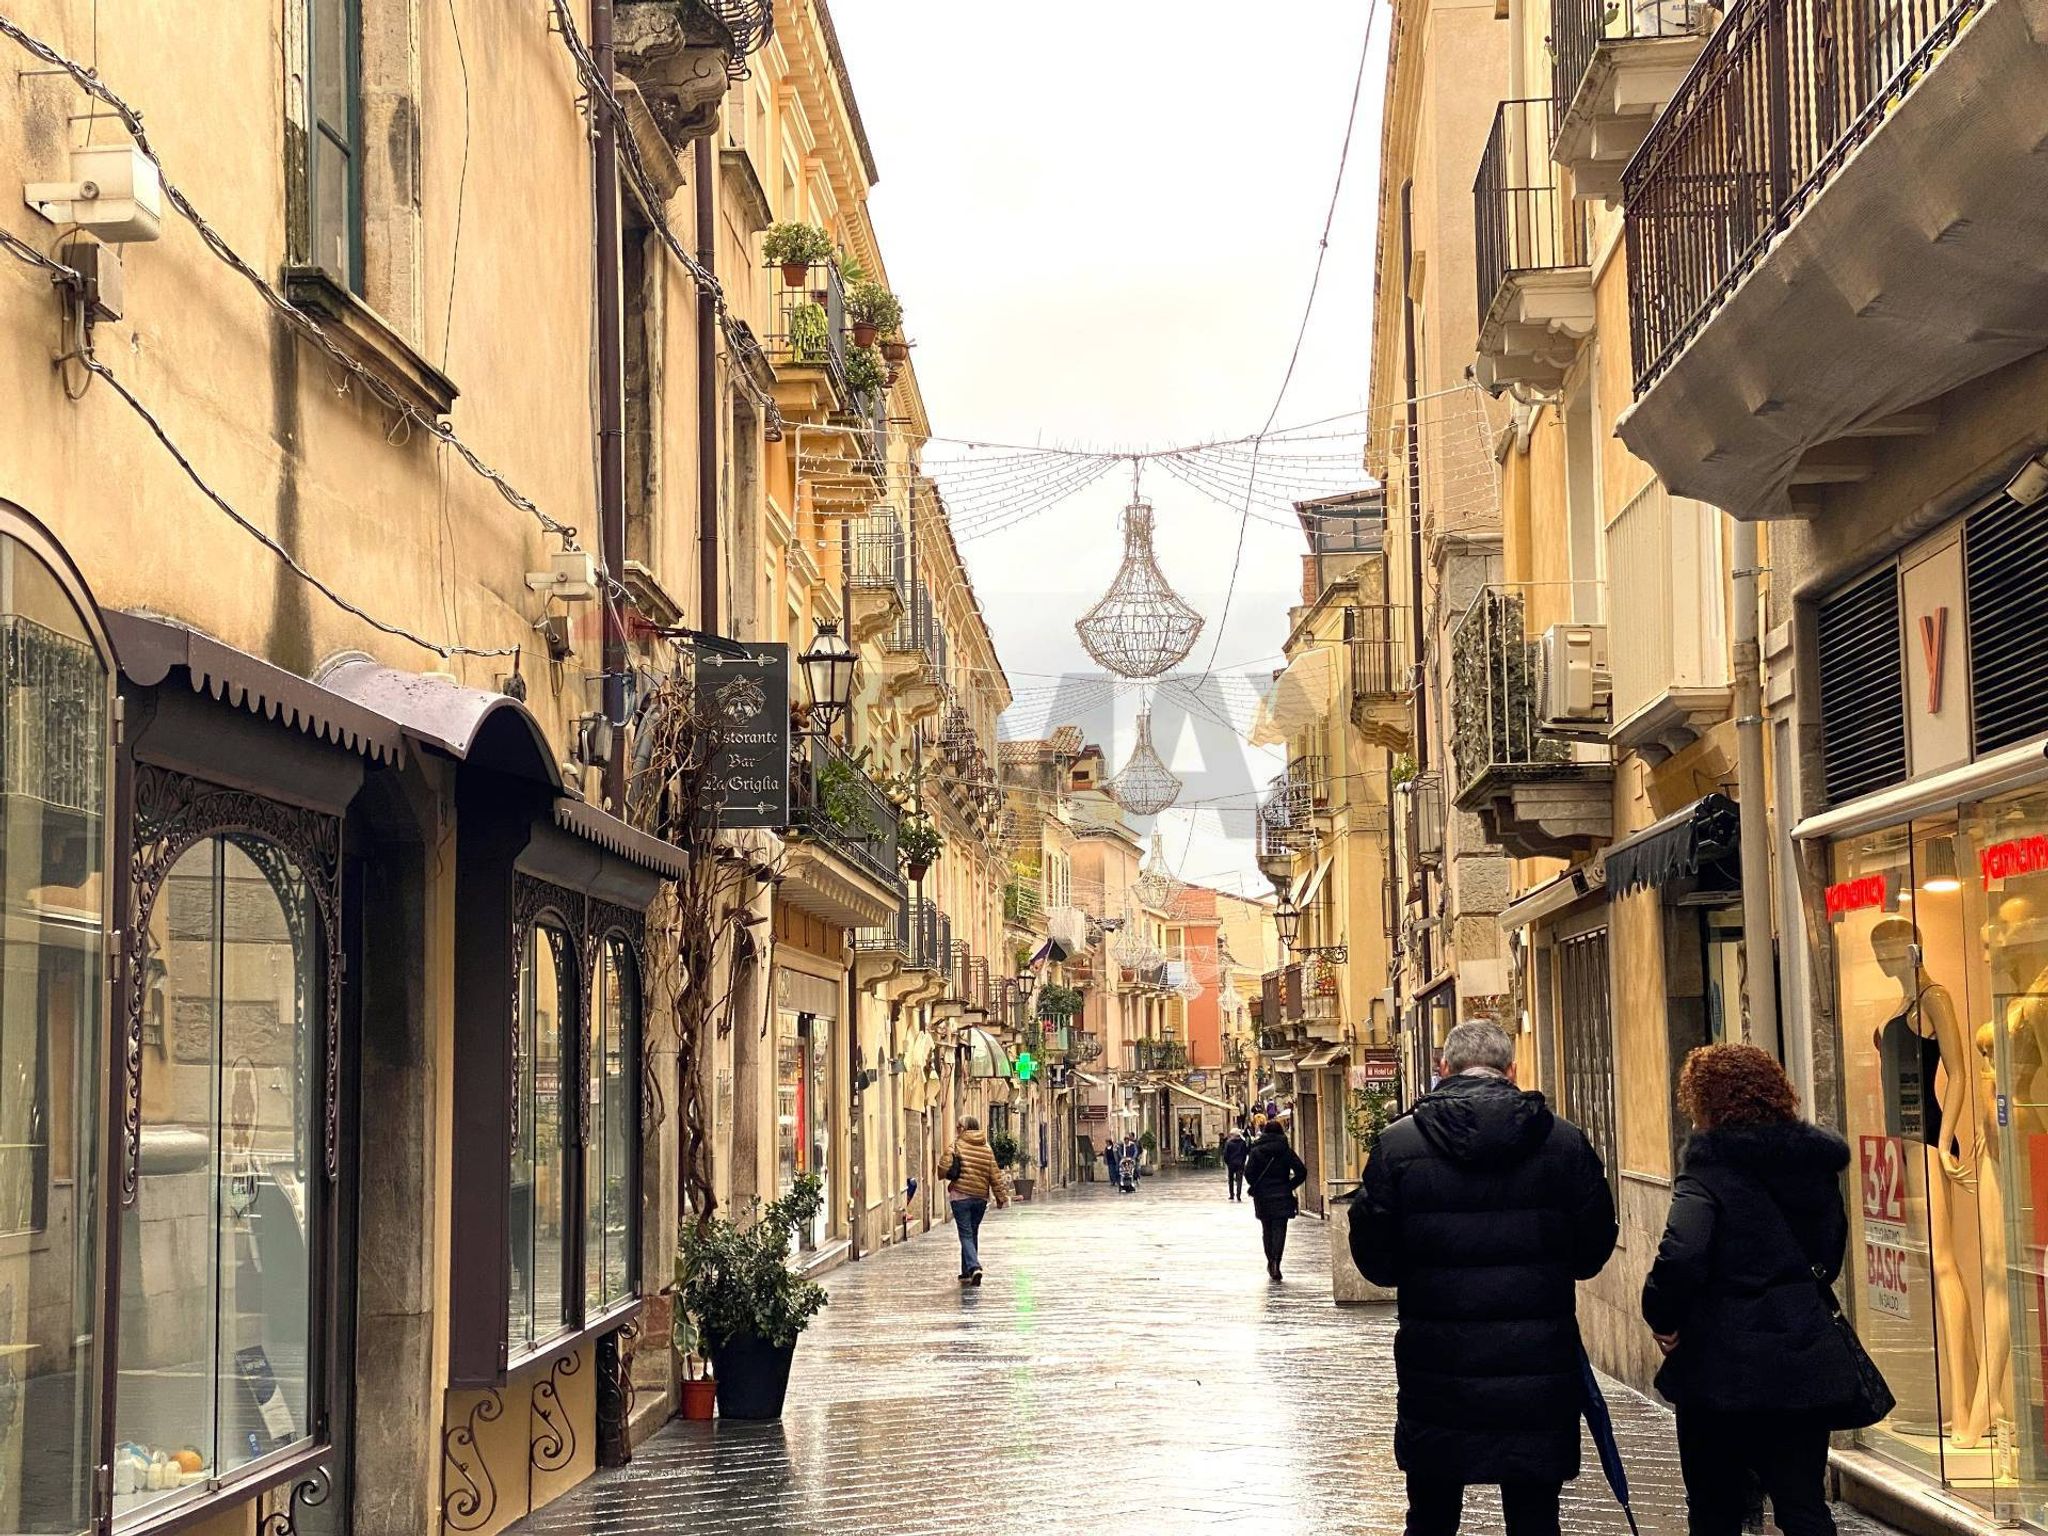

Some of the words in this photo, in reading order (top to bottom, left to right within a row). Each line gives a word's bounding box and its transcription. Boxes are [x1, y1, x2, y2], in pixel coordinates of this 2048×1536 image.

[727, 753, 756, 768] Bar
[728, 775, 780, 794] Griglia
[1867, 1244, 1907, 1294] BASIC
